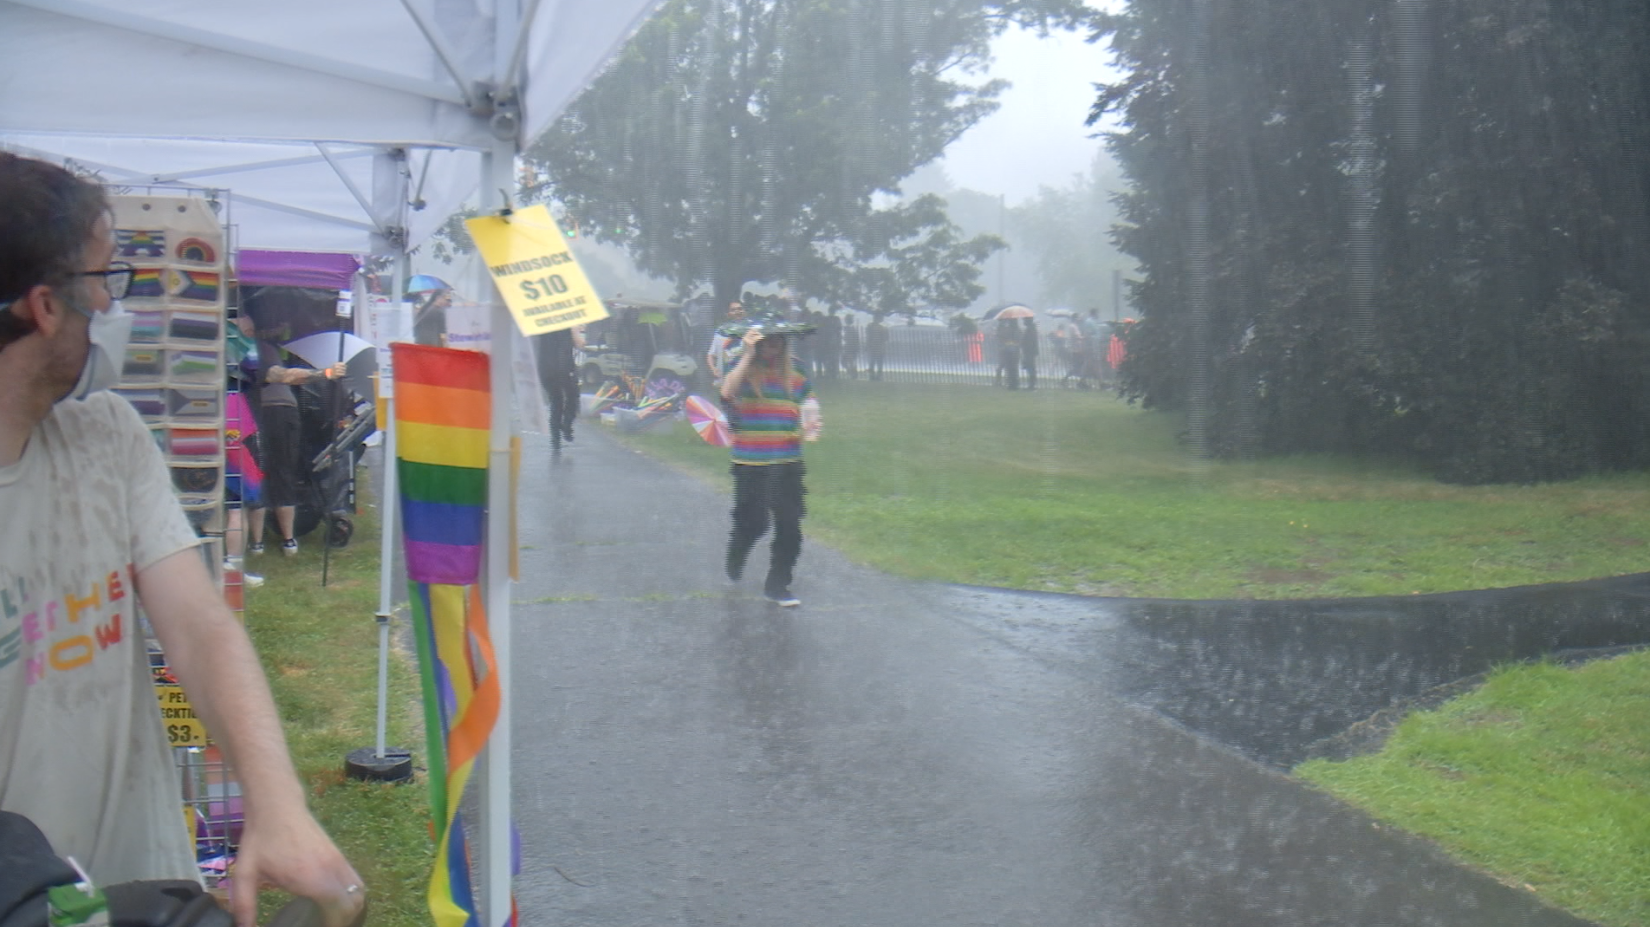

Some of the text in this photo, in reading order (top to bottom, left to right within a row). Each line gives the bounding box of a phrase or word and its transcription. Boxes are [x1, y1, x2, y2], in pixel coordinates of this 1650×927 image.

[489, 251, 573, 277] WINDSOCK
[519, 274, 569, 300] $10
[523, 296, 587, 317] AVAILABLE AT
[534, 308, 588, 327] CHECKOUT
